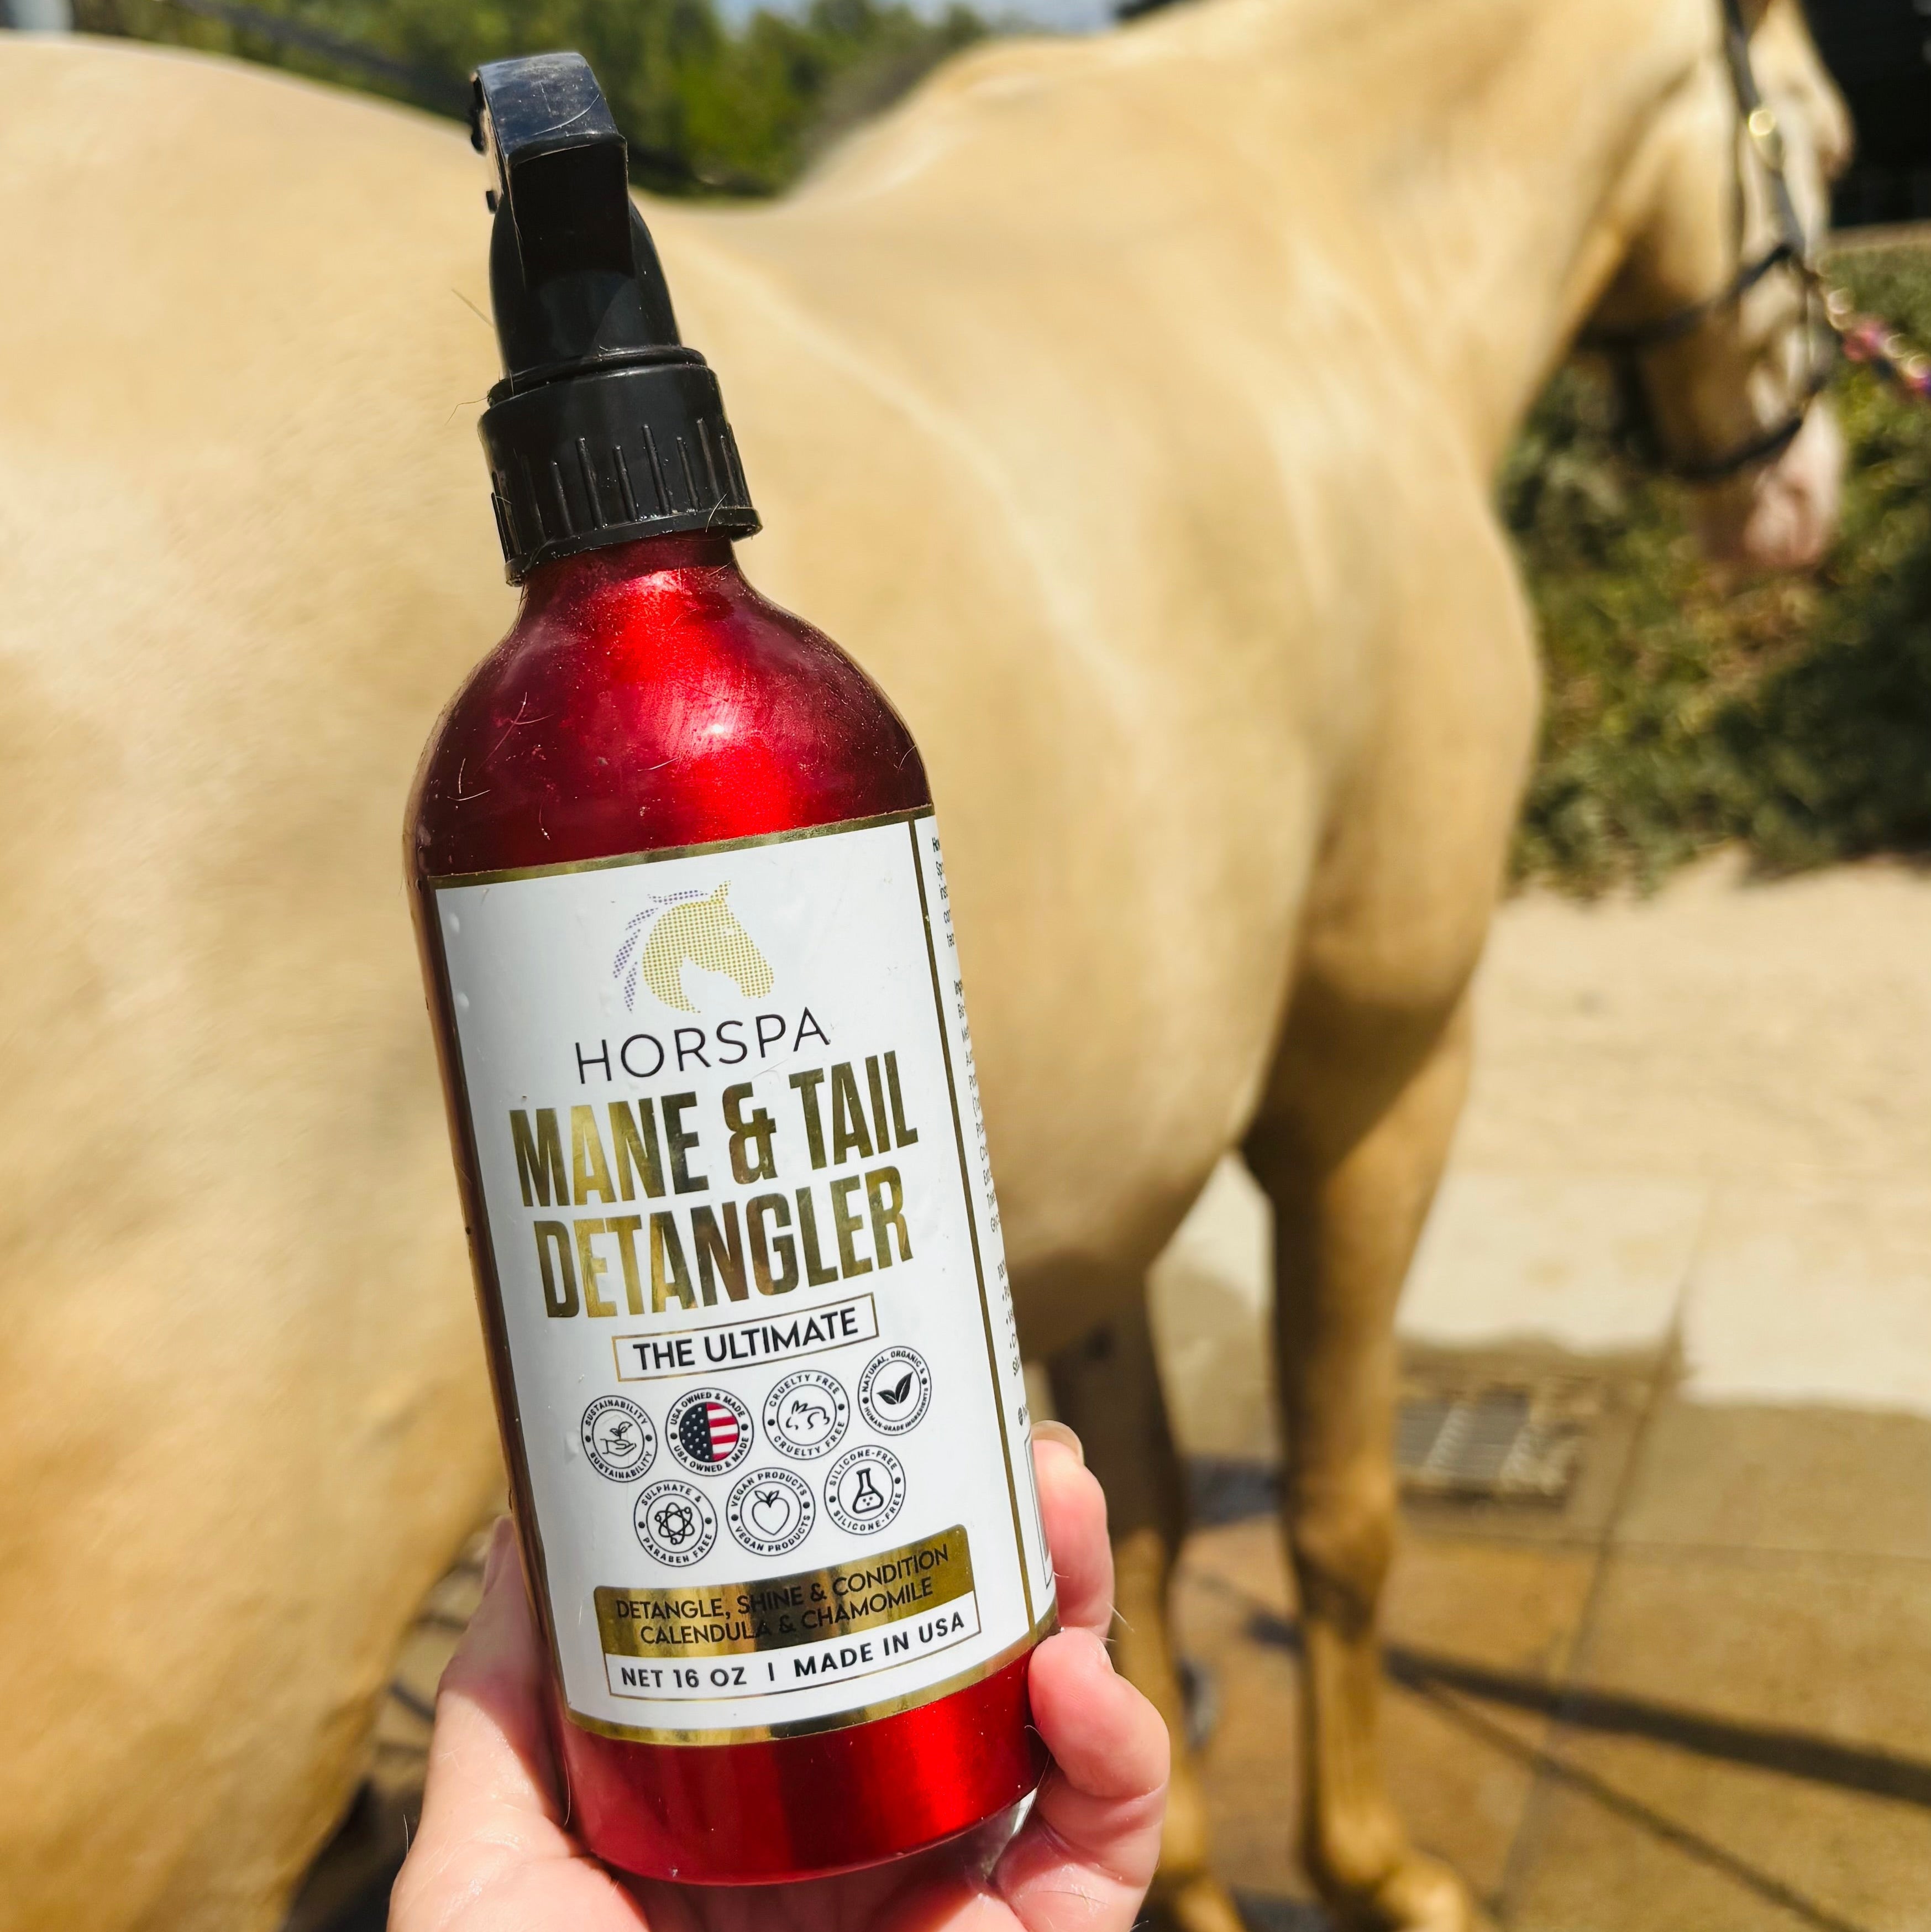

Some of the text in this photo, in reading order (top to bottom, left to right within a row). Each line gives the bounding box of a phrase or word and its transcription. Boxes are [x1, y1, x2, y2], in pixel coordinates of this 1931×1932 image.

[575, 1007, 831, 1083] HORSPA
[508, 1050, 919, 1207] MANE & TAIL
[533, 1166, 914, 1318] DETANGLER
[633, 1307, 858, 1370] THE ULTIMATE
[862, 1355, 889, 1392] NATURAL,
[890, 1350, 922, 1368] ORGANIC
[670, 1408, 683, 1425] USA
[681, 1391, 712, 1407] OWNED
[723, 1396, 746, 1417] MADE
[769, 1374, 839, 1407] CRUELTY FREE
[585, 1399, 648, 1426] SUSTAINABILITY
[864, 1406, 905, 1431] HUMAN-GRADE
[674, 1445, 688, 1463] USA
[689, 1460, 722, 1472] OWNED
[731, 1437, 749, 1462] MADE
[774, 1421, 844, 1457] CRUELTY FREE
[590, 1451, 653, 1479] SUSTAINABILITY
[829, 1449, 898, 1486] SILICONE-FREE
[641, 1484, 692, 1506] SULPHATE
[731, 1472, 807, 1507] VEGAN PRODUCTS
[833, 1493, 901, 1531] SILICONE-FREE
[643, 1533, 712, 1563] PARABEN FREE
[735, 1515, 810, 1552] VEGAN PRODUCTS
[617, 1543, 949, 1620] DETANGLE, SHINE & CONDITION
[641, 1577, 933, 1645] CALENDULA & CHAMOMILE
[621, 1667, 663, 1688] NET
[673, 1668, 700, 1688] 16
[710, 1665, 747, 1687] OZ
[794, 1642, 873, 1678] MADE
[884, 1630, 910, 1656] IN
[919, 1611, 966, 1643] USA
